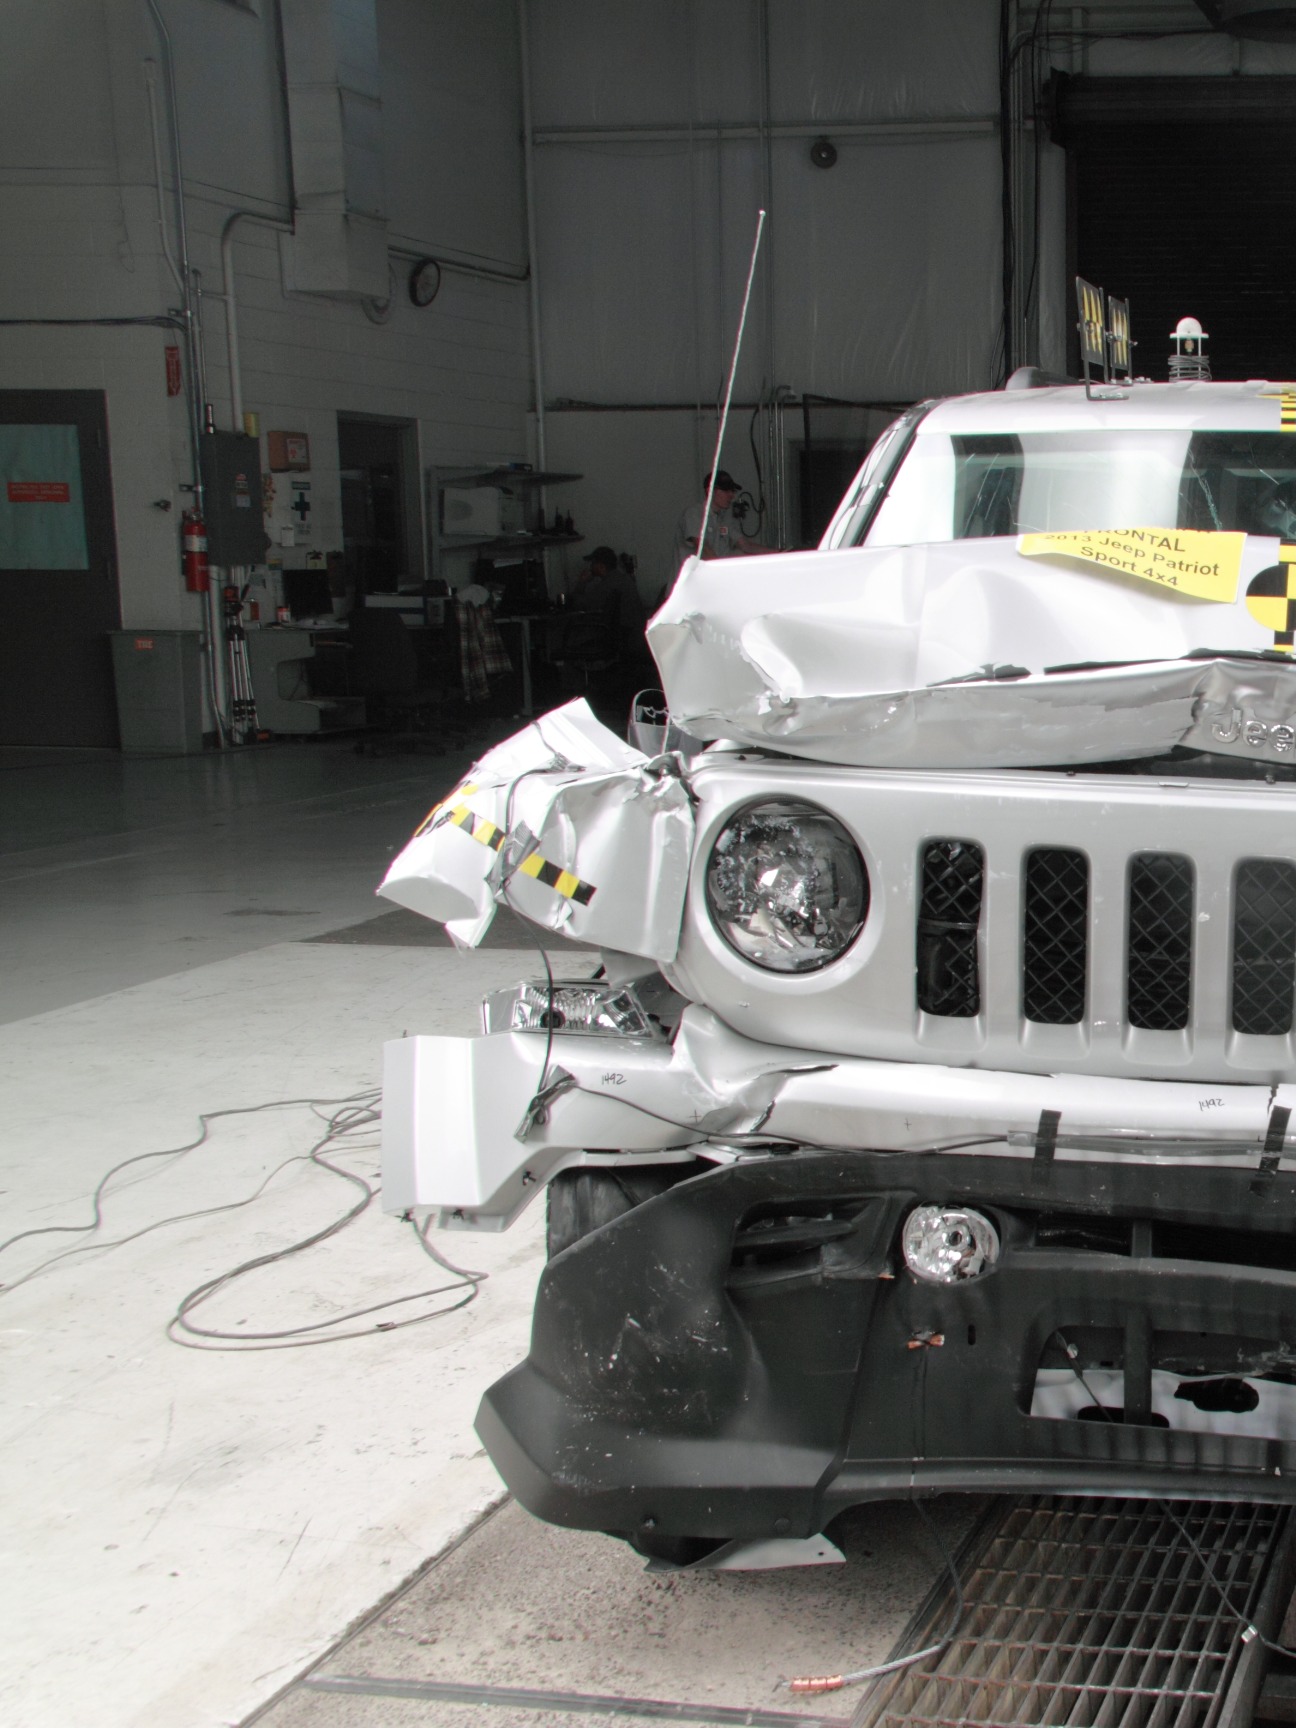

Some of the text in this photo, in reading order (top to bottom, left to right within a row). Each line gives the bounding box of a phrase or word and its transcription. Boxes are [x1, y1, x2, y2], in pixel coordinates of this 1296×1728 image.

[1083, 528, 1186, 552] ONTAL
[1044, 534, 1220, 576] 2013 Jeep Patriot
[1080, 546, 1179, 586] Sport 4x4
[601, 1073, 627, 1085] 1492
[1198, 1098, 1225, 1111] 1492
